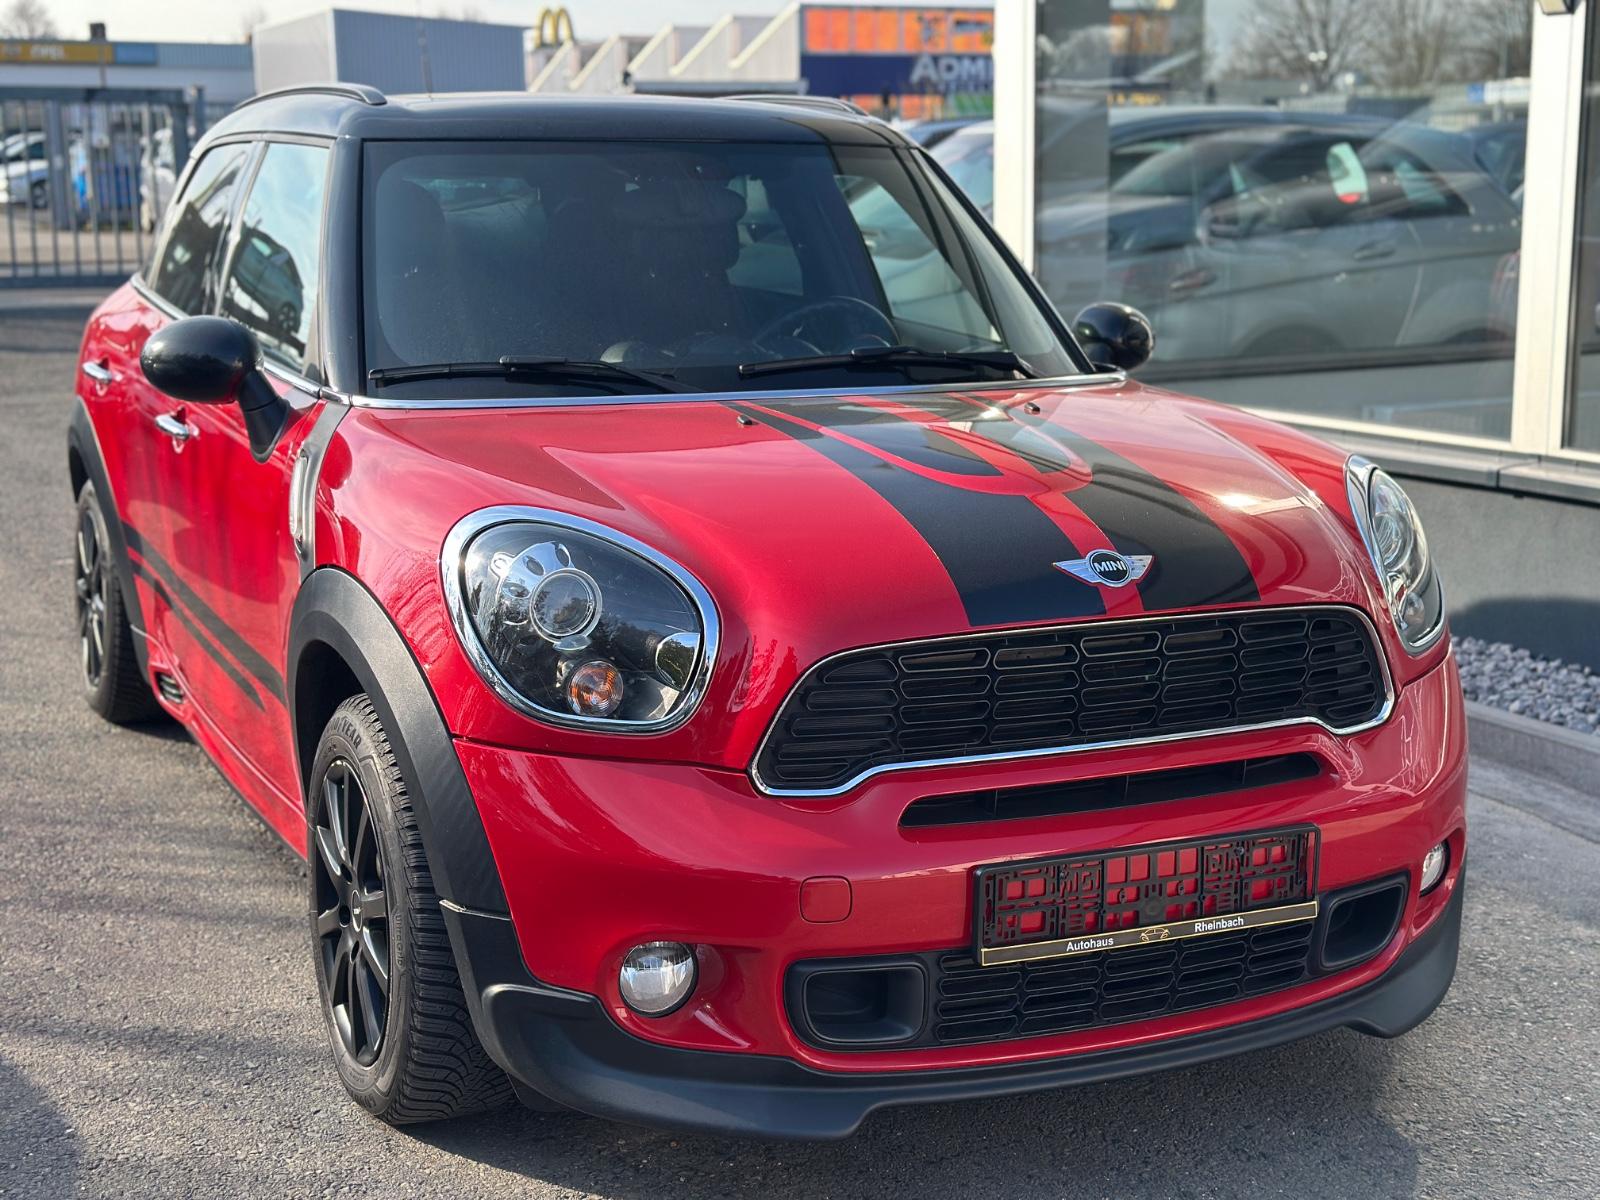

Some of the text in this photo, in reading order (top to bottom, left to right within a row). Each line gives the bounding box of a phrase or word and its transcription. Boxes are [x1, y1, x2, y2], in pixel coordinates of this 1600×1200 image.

[1093, 560, 1127, 572] MINI
[1066, 916, 1244, 952] Autohaus Rheinbach
